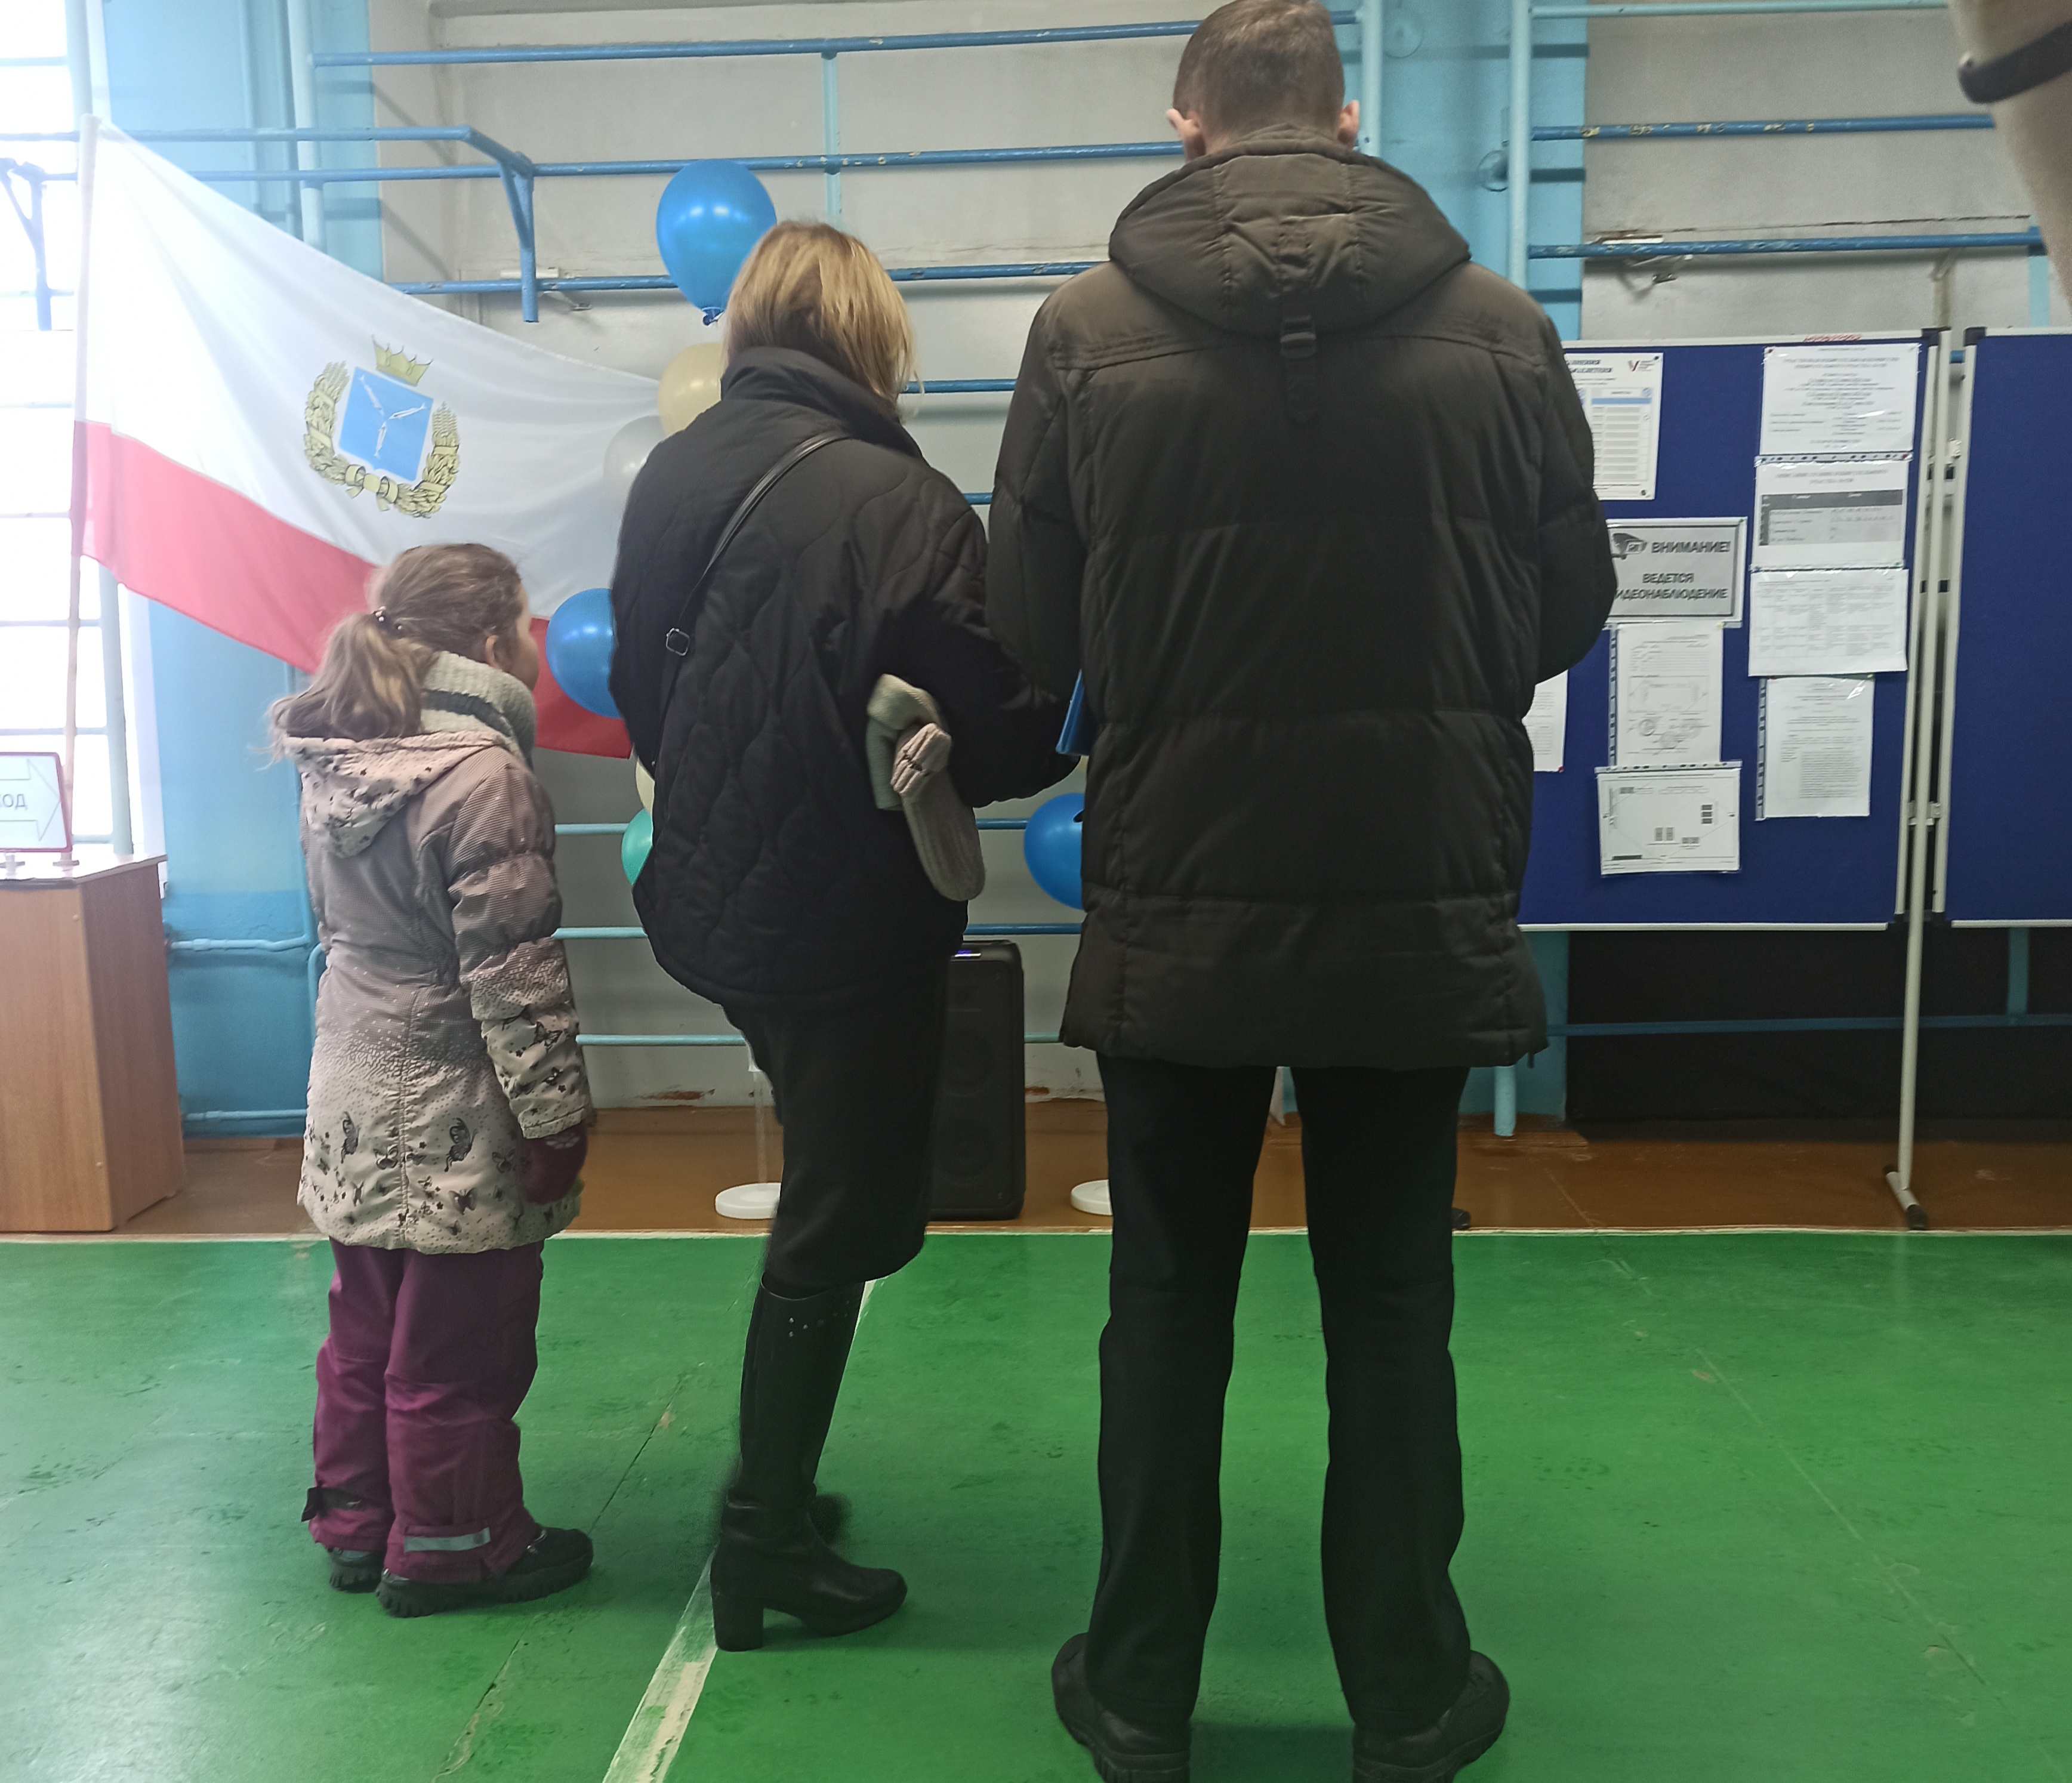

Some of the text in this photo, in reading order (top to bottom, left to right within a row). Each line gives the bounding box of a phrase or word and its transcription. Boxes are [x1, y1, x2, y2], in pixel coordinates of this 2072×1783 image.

[1642, 573, 1694, 585] ВЕДЕТСЯ
[1615, 588, 1729, 601] ИДЕОНАБЛЮДЕНИЕ
[0, 793, 28, 810] ОД
